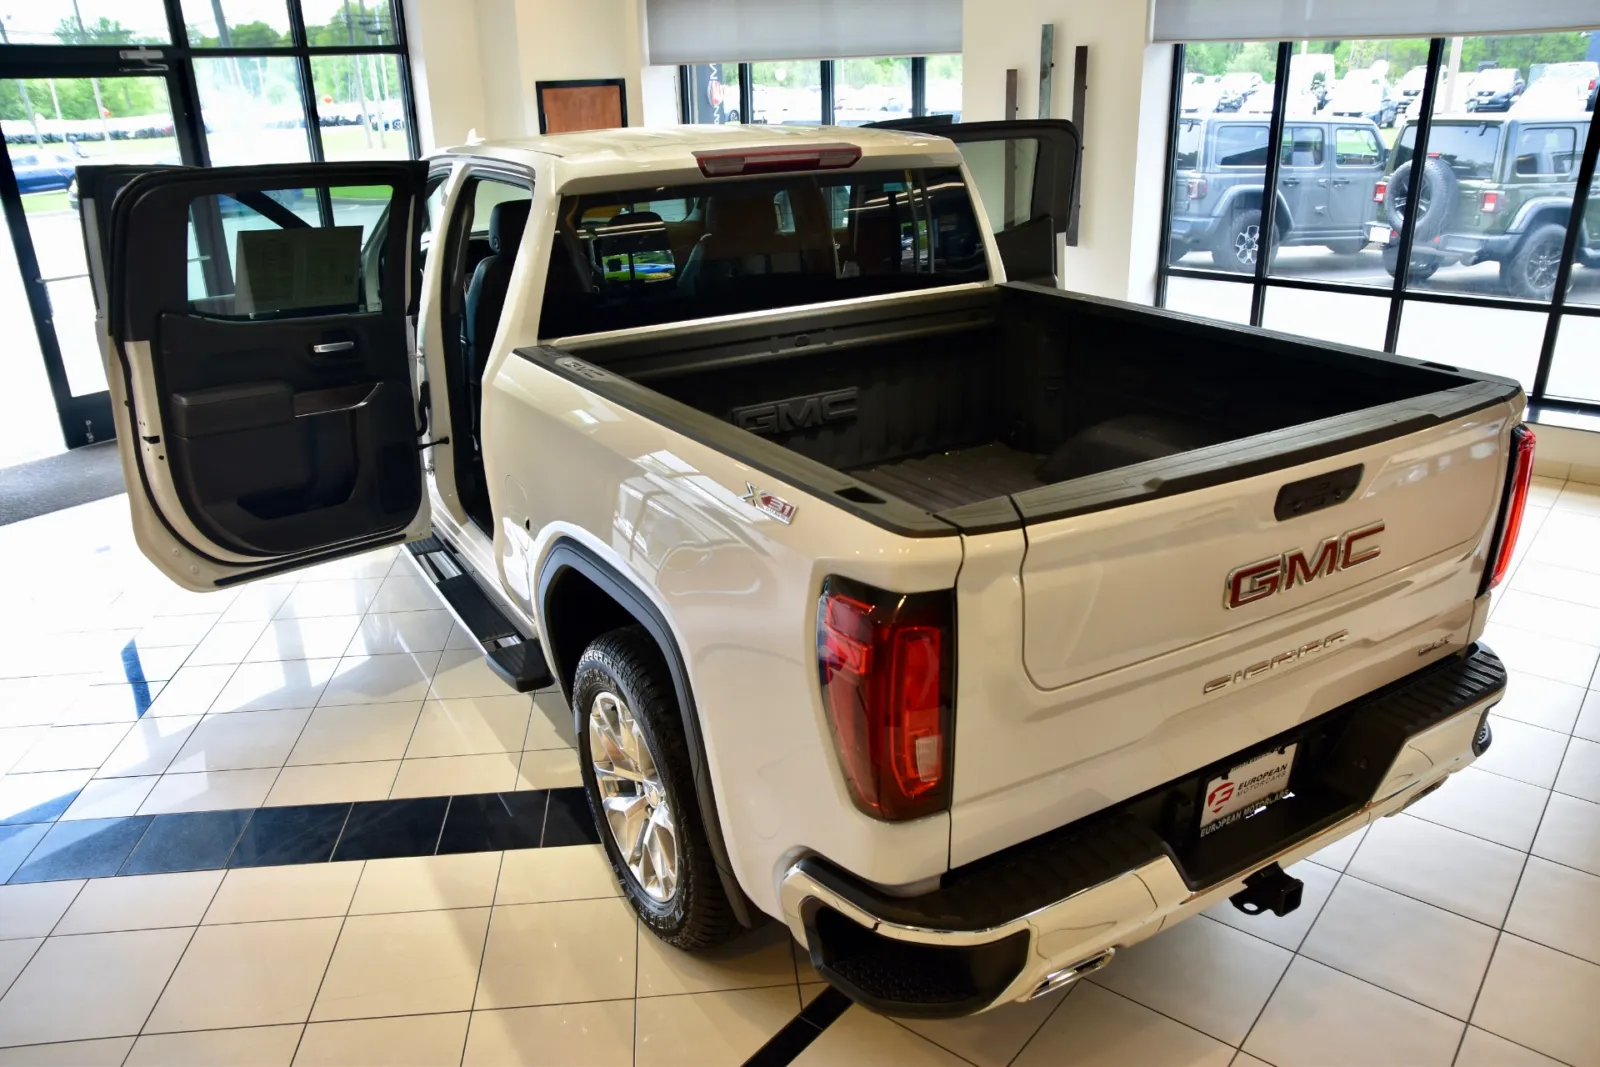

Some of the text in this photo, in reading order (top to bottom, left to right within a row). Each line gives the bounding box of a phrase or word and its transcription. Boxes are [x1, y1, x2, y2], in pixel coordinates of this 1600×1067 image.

[732, 387, 859, 433] GMC
[742, 481, 796, 521] X31
[1223, 519, 1386, 610] GMC
[1203, 629, 1349, 694] SIERRA
[1236, 771, 1287, 797] MOTORCARS
[1238, 763, 1289, 790] EUROPEAN
[1200, 811, 1242, 838] EUROPEAN
